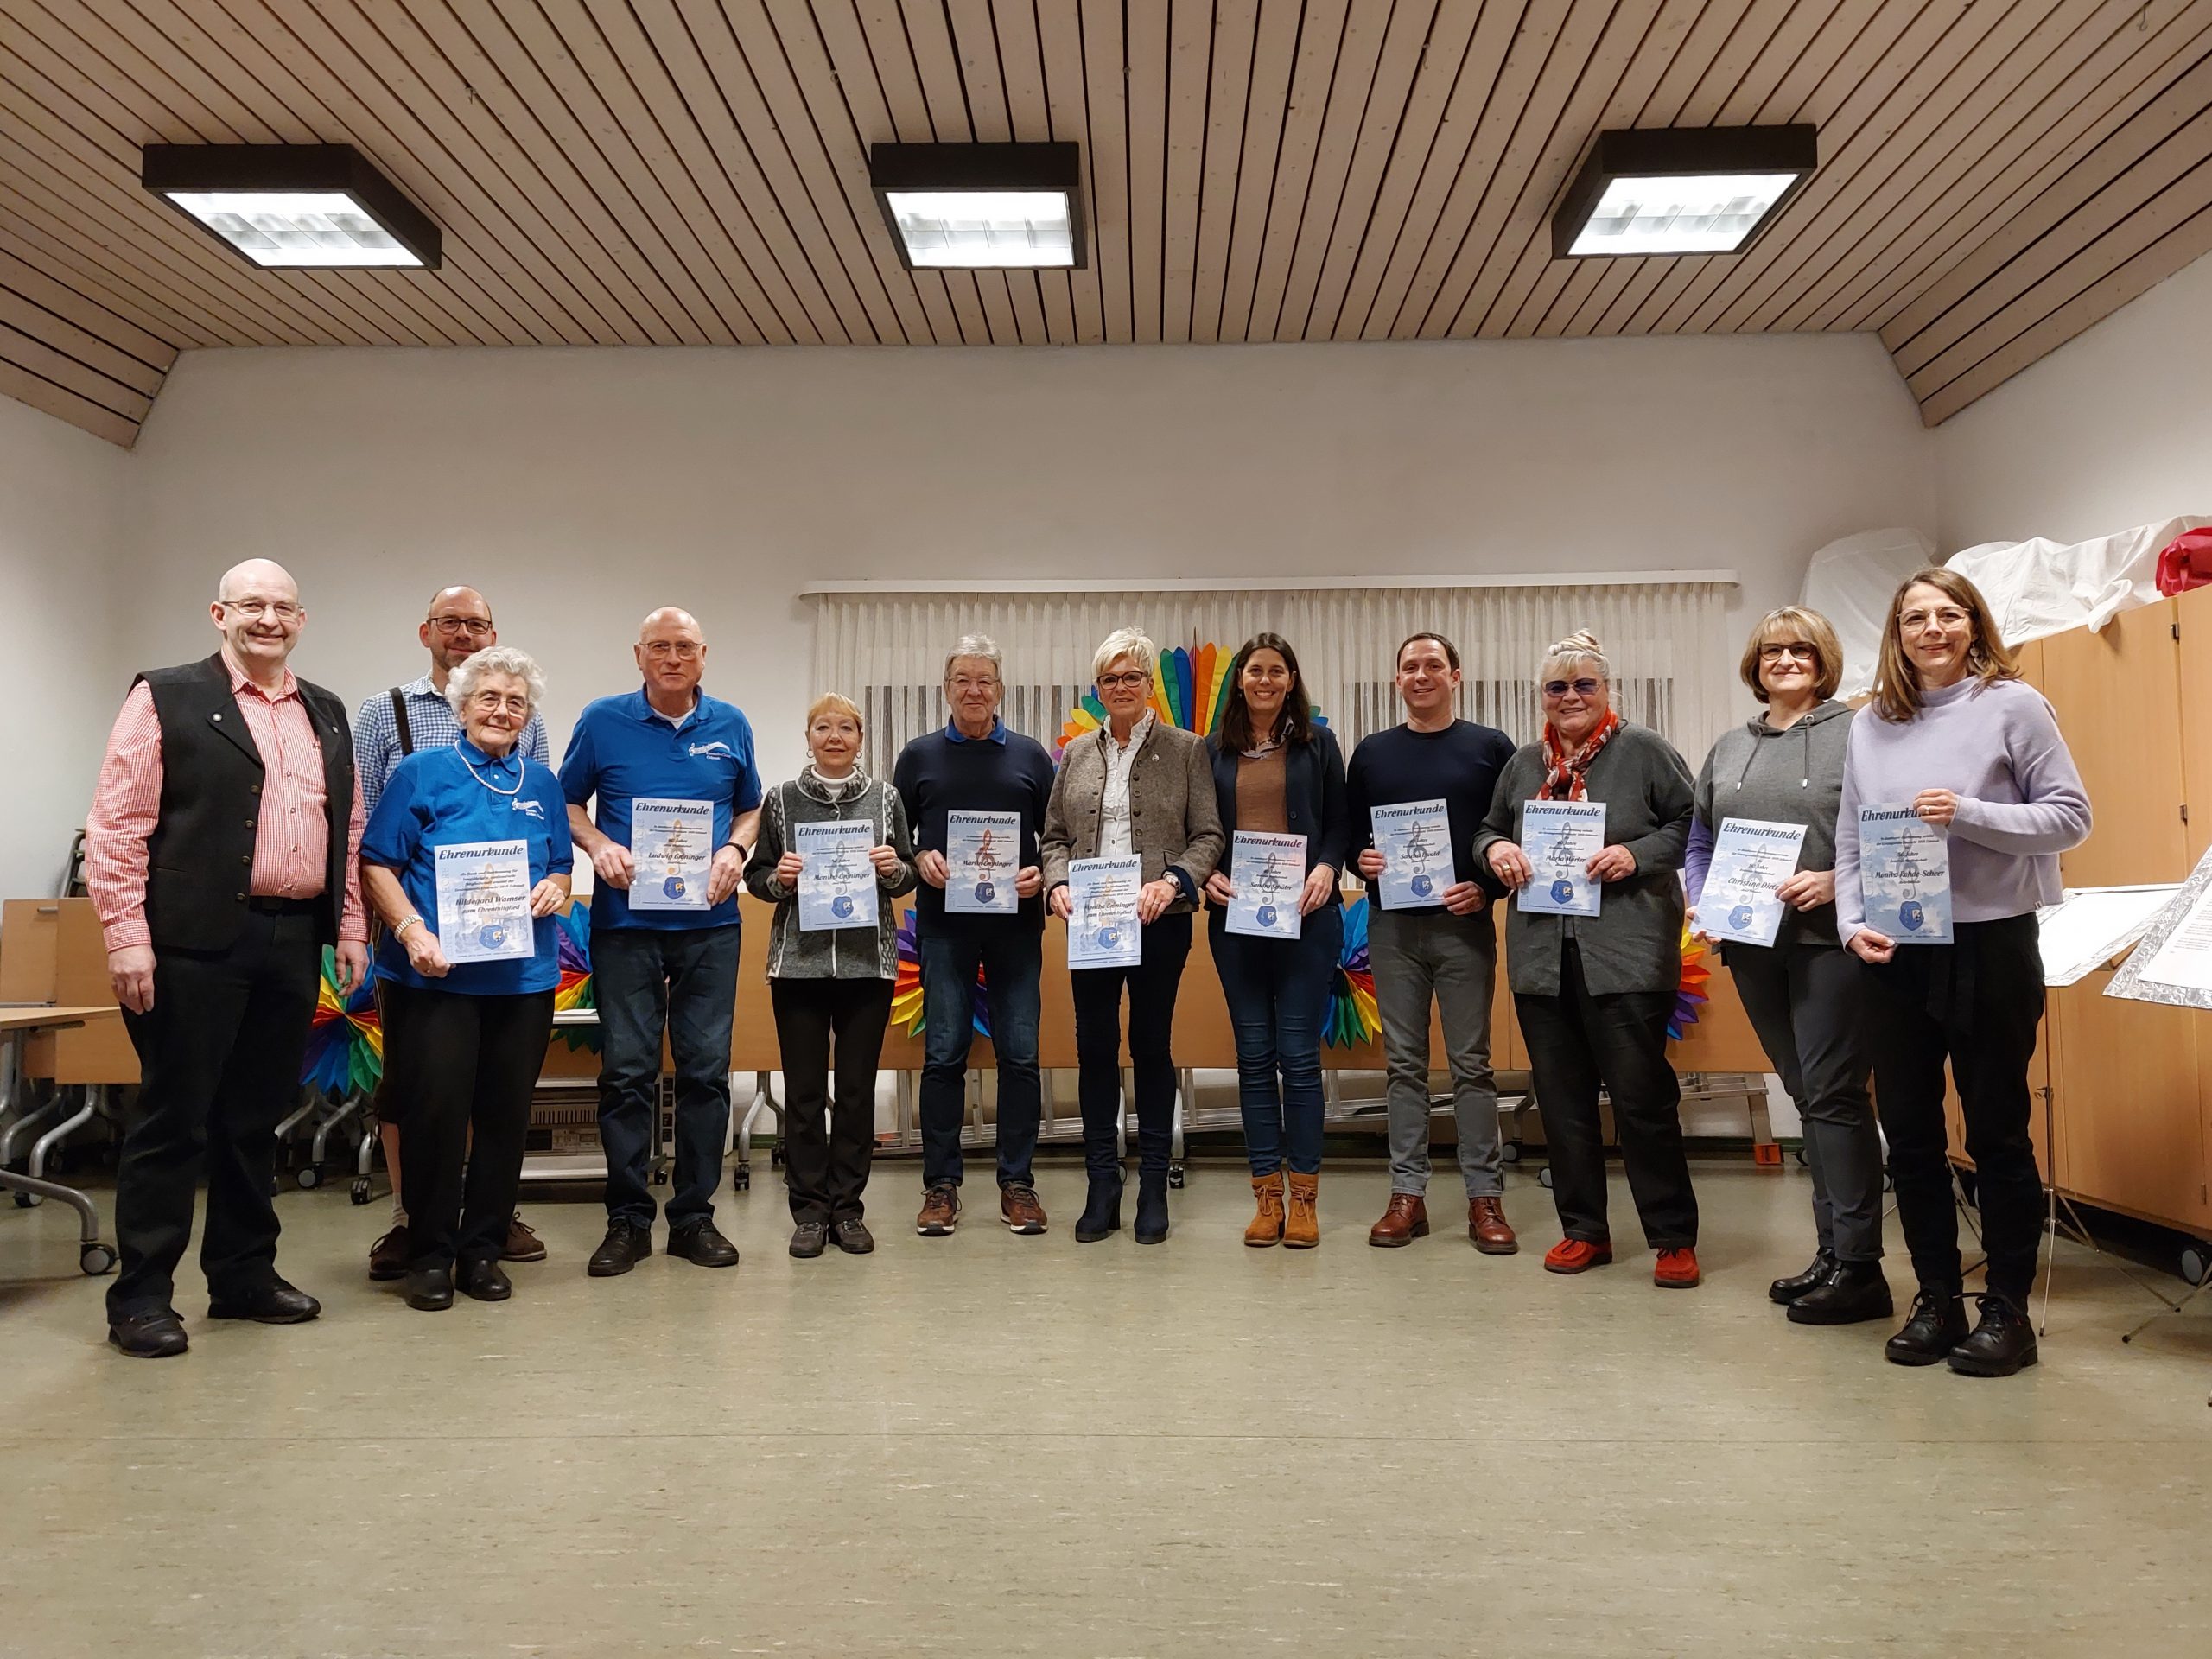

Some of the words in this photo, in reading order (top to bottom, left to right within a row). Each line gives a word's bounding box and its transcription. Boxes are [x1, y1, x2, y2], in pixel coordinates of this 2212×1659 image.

[635, 802, 709, 815] Ehrenurkunde
[1375, 804, 1445, 819] Ehrenurkunde
[1525, 804, 1601, 817] Ehrenurkunde
[950, 814, 1016, 825] Ehrenurkunde
[798, 824, 871, 836] Ehrenurkunde
[1723, 823, 1801, 841] Ehrenurkunde
[1234, 835, 1303, 848] Ehrenurkunde
[439, 845, 524, 860] Ehrenurkunde
[648, 852, 673, 861] Ludwig
[1071, 859, 1137, 873] Ehrenurkunde
[1875, 870, 1898, 879] Monika
[1728, 877, 1761, 888] Christine
[455, 895, 493, 906] Hildegard
[477, 905, 520, 913] Ehrenmitglied
